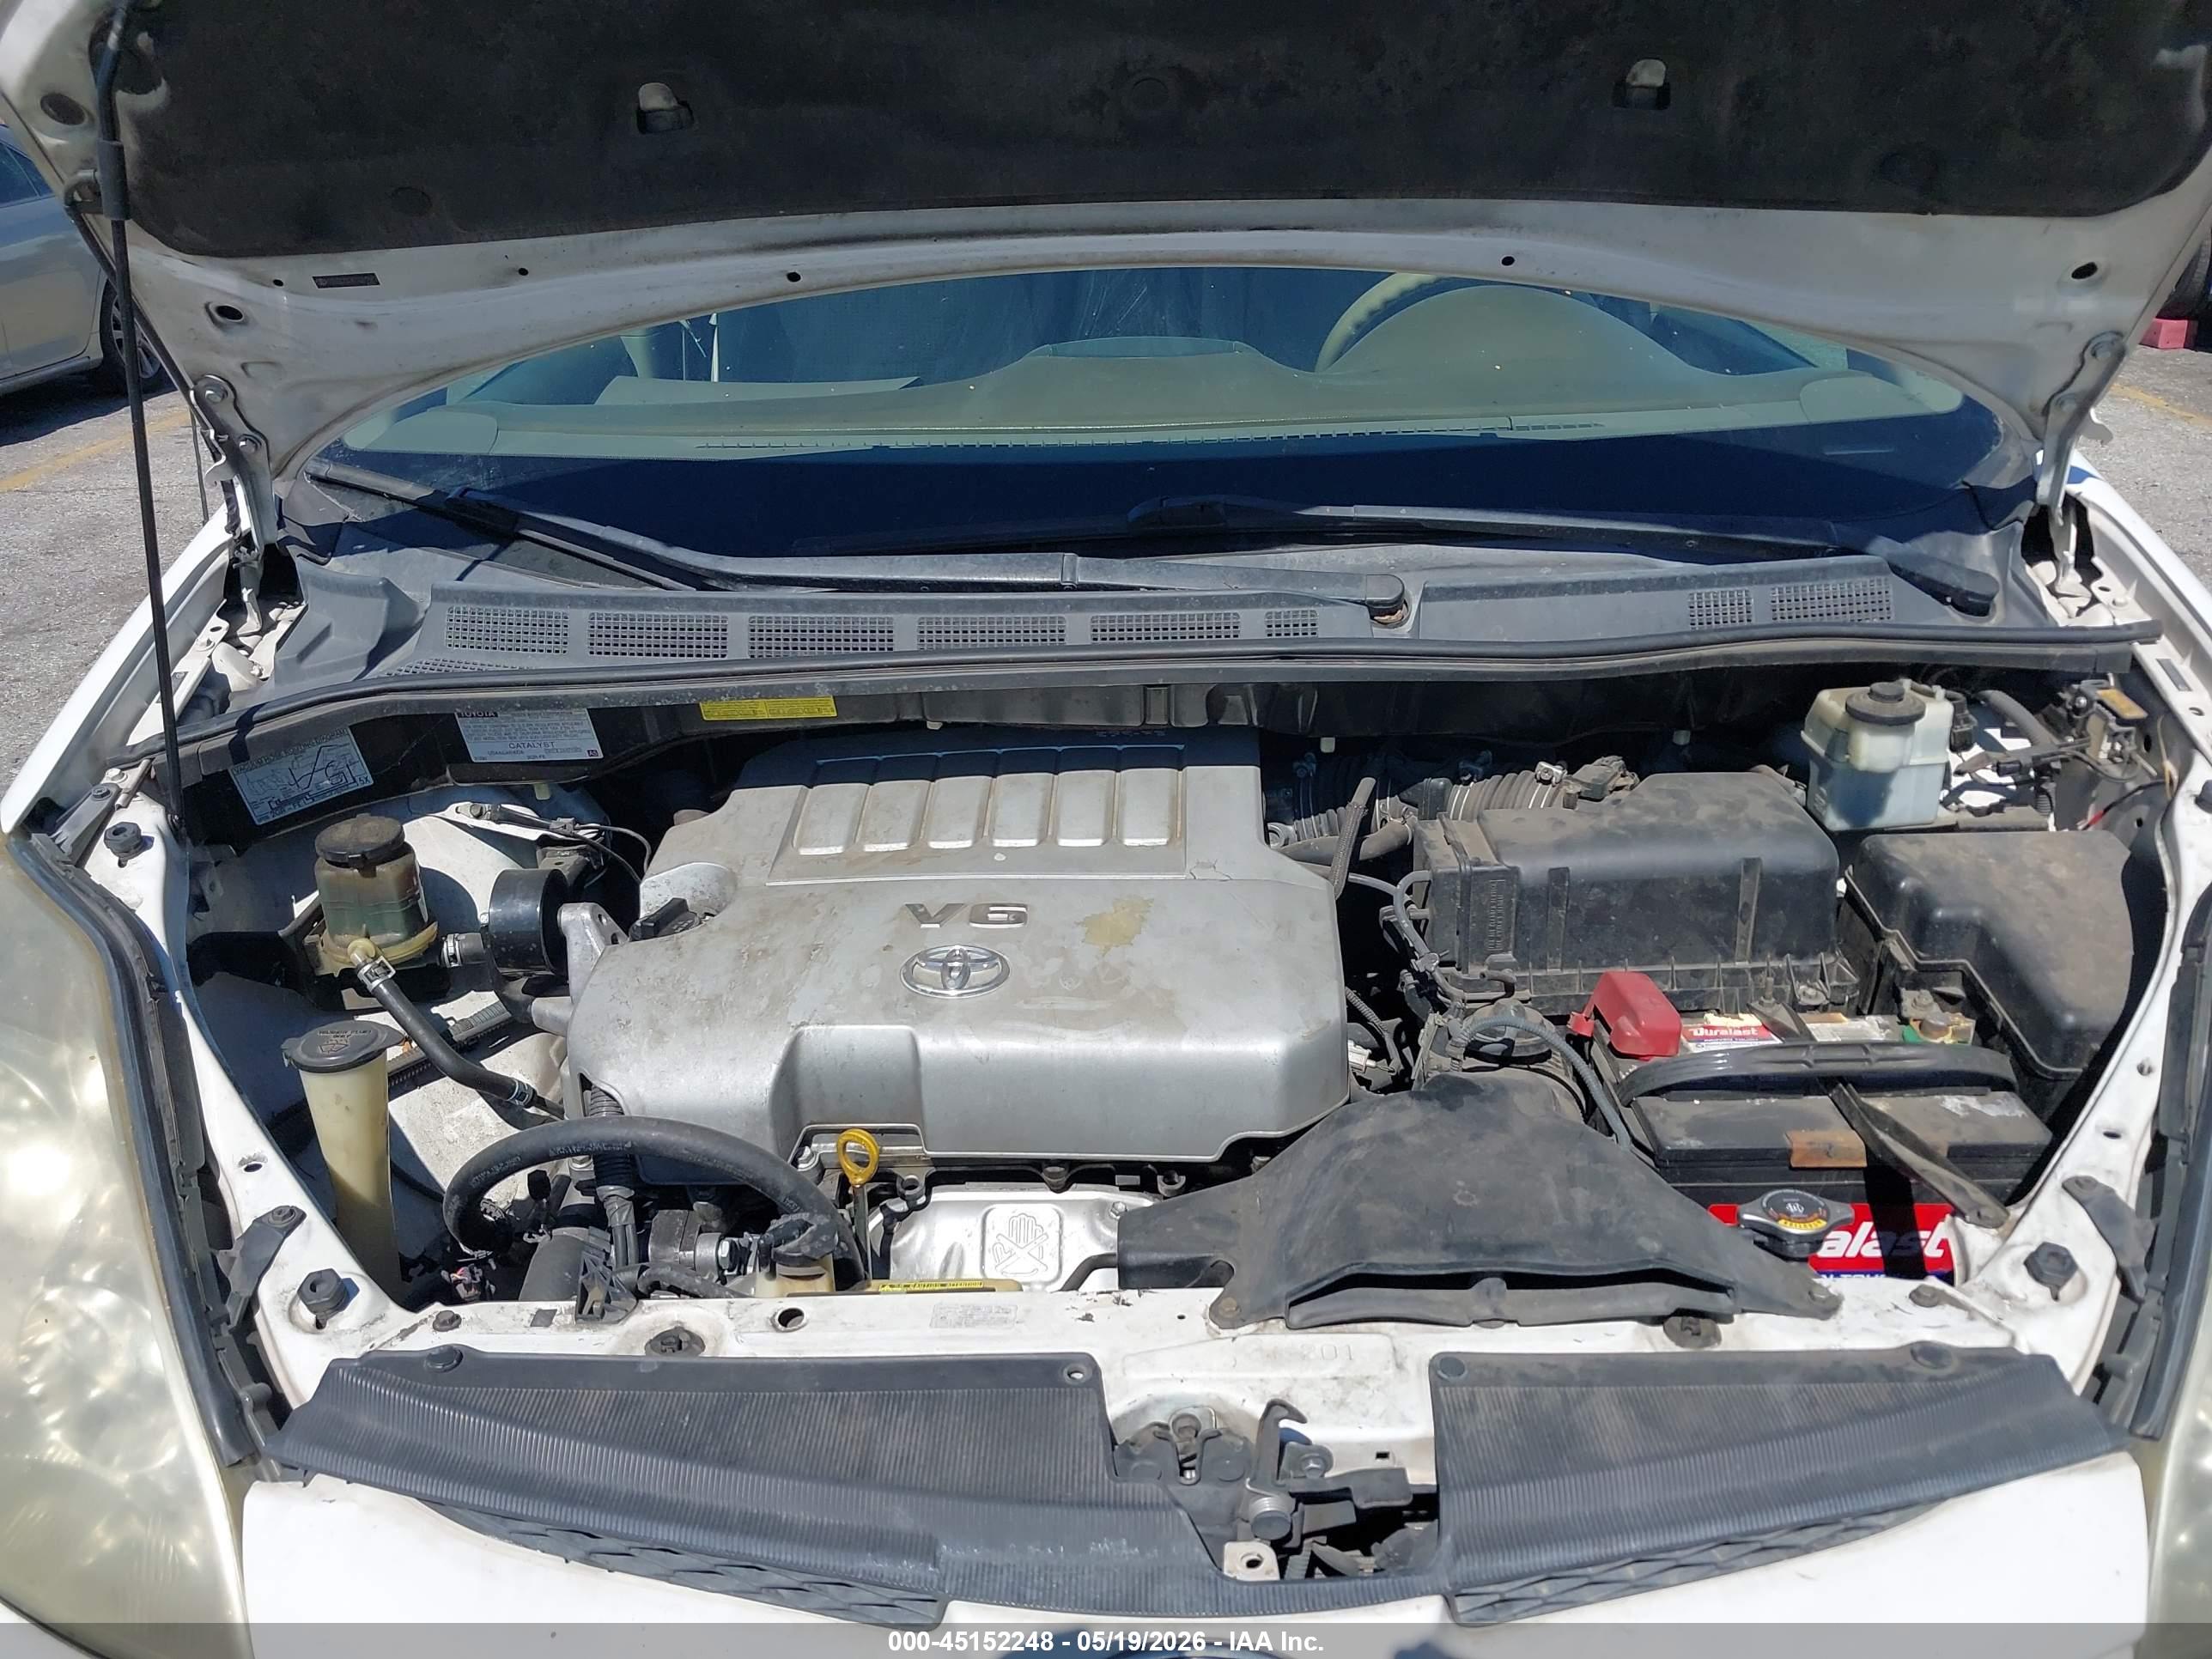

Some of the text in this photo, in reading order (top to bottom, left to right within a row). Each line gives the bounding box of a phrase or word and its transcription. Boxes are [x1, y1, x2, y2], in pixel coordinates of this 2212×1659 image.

[508, 741, 556, 750] CATALYST
[905, 902, 1029, 928] V6
[1688, 1027, 1759, 1036] Duralast
[1818, 1222, 1947, 1258] alast
